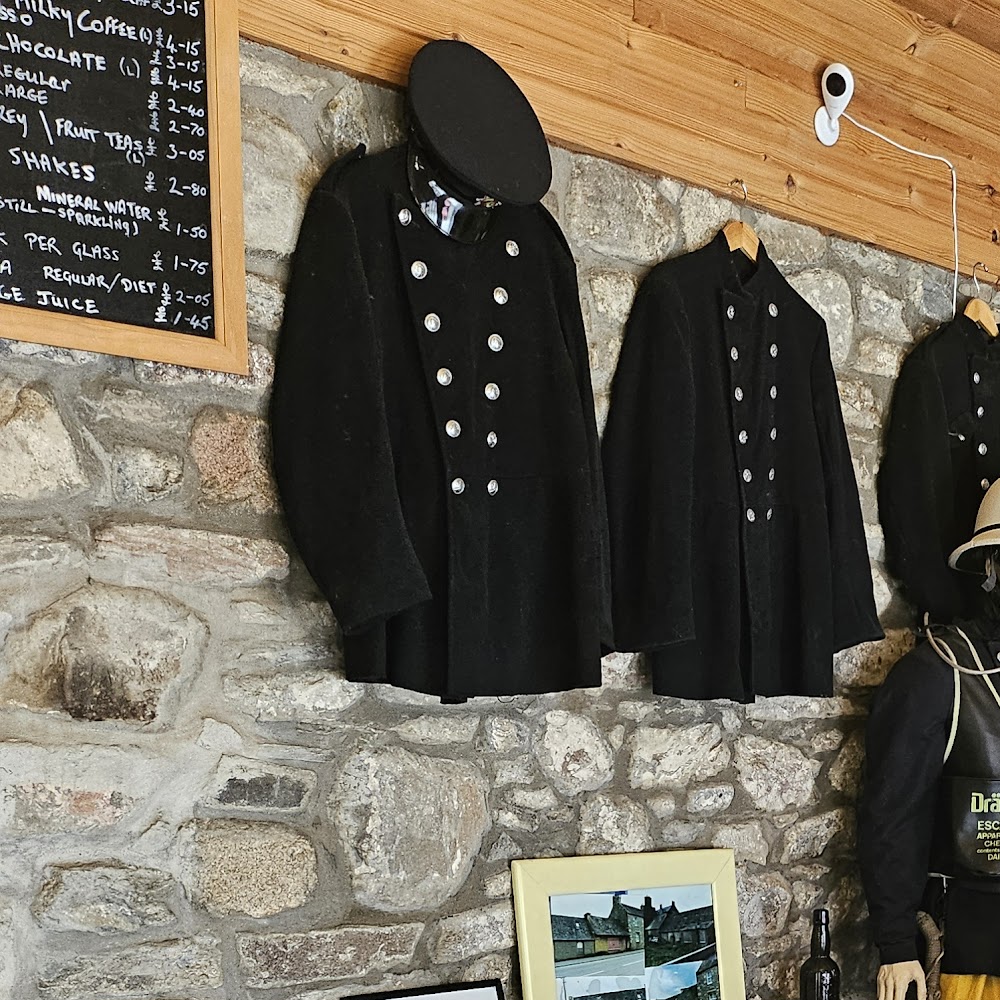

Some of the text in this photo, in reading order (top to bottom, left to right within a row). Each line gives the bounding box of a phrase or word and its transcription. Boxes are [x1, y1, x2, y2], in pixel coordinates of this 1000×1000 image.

[0, 83, 48, 105] ARGE
[8, 147, 96, 182] SHAKES
[36, 185, 103, 212] MINERAL
[104, 199, 153, 222] WATER
[24, 232, 63, 256] PER
[72, 241, 120, 262] GLASS
[36, 290, 100, 315] JUICE
